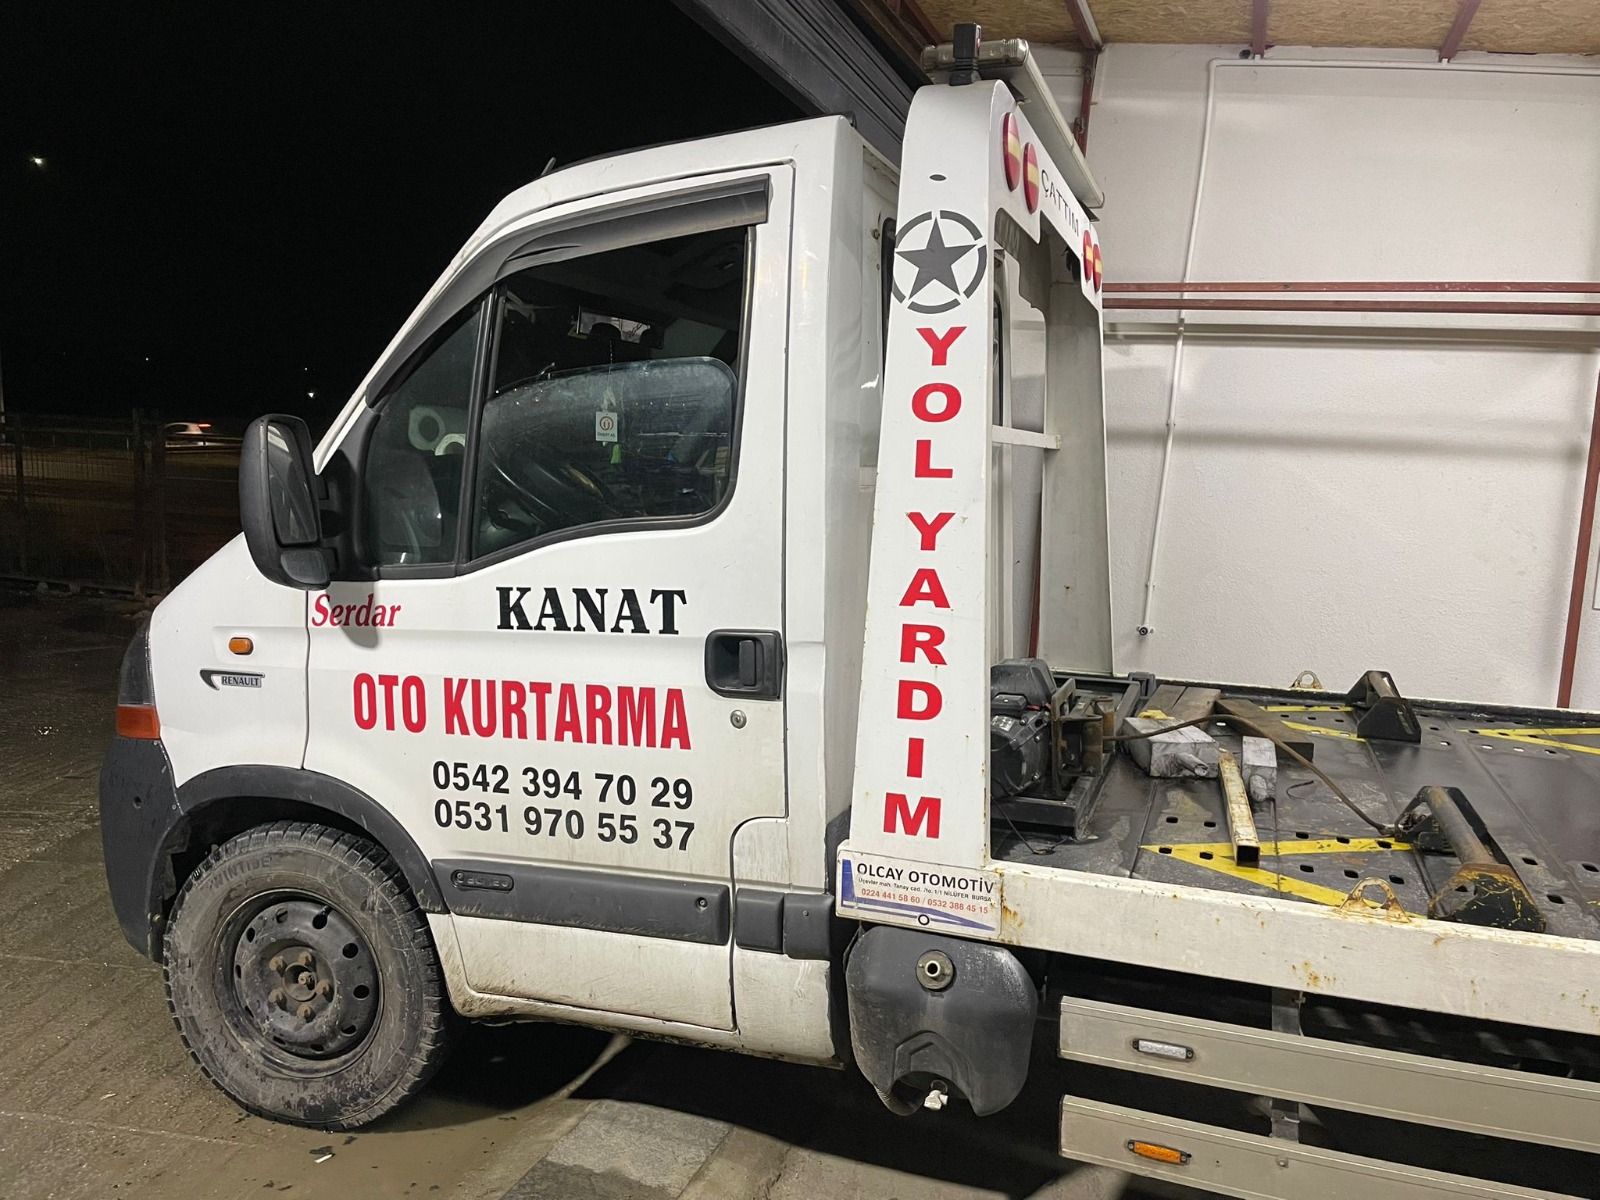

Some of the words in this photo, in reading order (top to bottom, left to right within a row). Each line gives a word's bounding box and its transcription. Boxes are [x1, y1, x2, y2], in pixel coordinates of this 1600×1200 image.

[1041, 169, 1080, 238] ÇATTIM
[911, 326, 966, 479] YOL
[311, 593, 401, 627] Serdar
[495, 586, 687, 635] KANAT
[222, 675, 260, 687] RENAULT
[883, 511, 955, 839] YARDIM
[353, 672, 427, 734] OTO
[443, 677, 691, 751] KURTARMA
[432, 760, 510, 795] 0542
[522, 766, 583, 801] 394
[594, 772, 637, 806] 70
[650, 776, 693, 810] 29
[434, 798, 509, 833] 0531
[523, 806, 585, 840] 970
[597, 812, 638, 845] 55
[653, 818, 695, 851] 37
[857, 863, 905, 881] OLCAY
[908, 870, 994, 894] OTOMOTİV
[861, 888, 880, 897] 0224
[882, 891, 896, 900] 441
[898, 894, 908, 902] 58
[910, 896, 920, 904] 60
[927, 898, 947, 908] 0532
[949, 901, 964, 911] 388
[966, 904, 976, 912] 45
[979, 906, 988, 914] 15
[943, 890, 969, 899] NİLÜFER
[971, 894, 992, 902] BURSA
